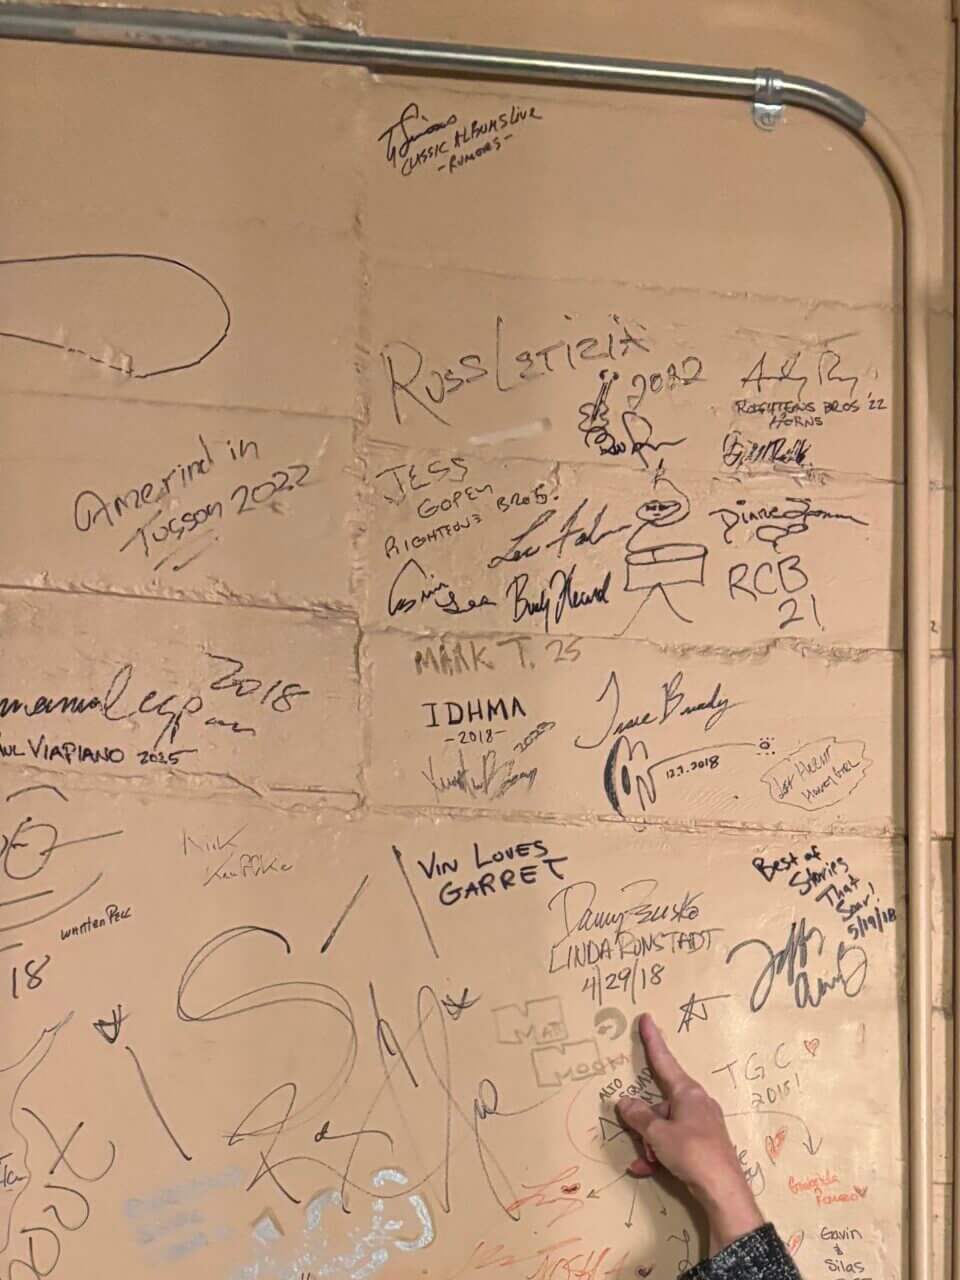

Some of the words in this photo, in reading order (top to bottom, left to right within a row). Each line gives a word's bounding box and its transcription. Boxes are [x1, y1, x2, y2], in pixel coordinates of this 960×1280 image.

[728, 554, 809, 601] RCB
[418, 851, 458, 879] VIN
[474, 840, 548, 868] LOVES
[752, 852, 798, 882] Best
[789, 857, 850, 896] Stories
[816, 875, 860, 907] That
[824, 1258, 866, 1273] Silas
